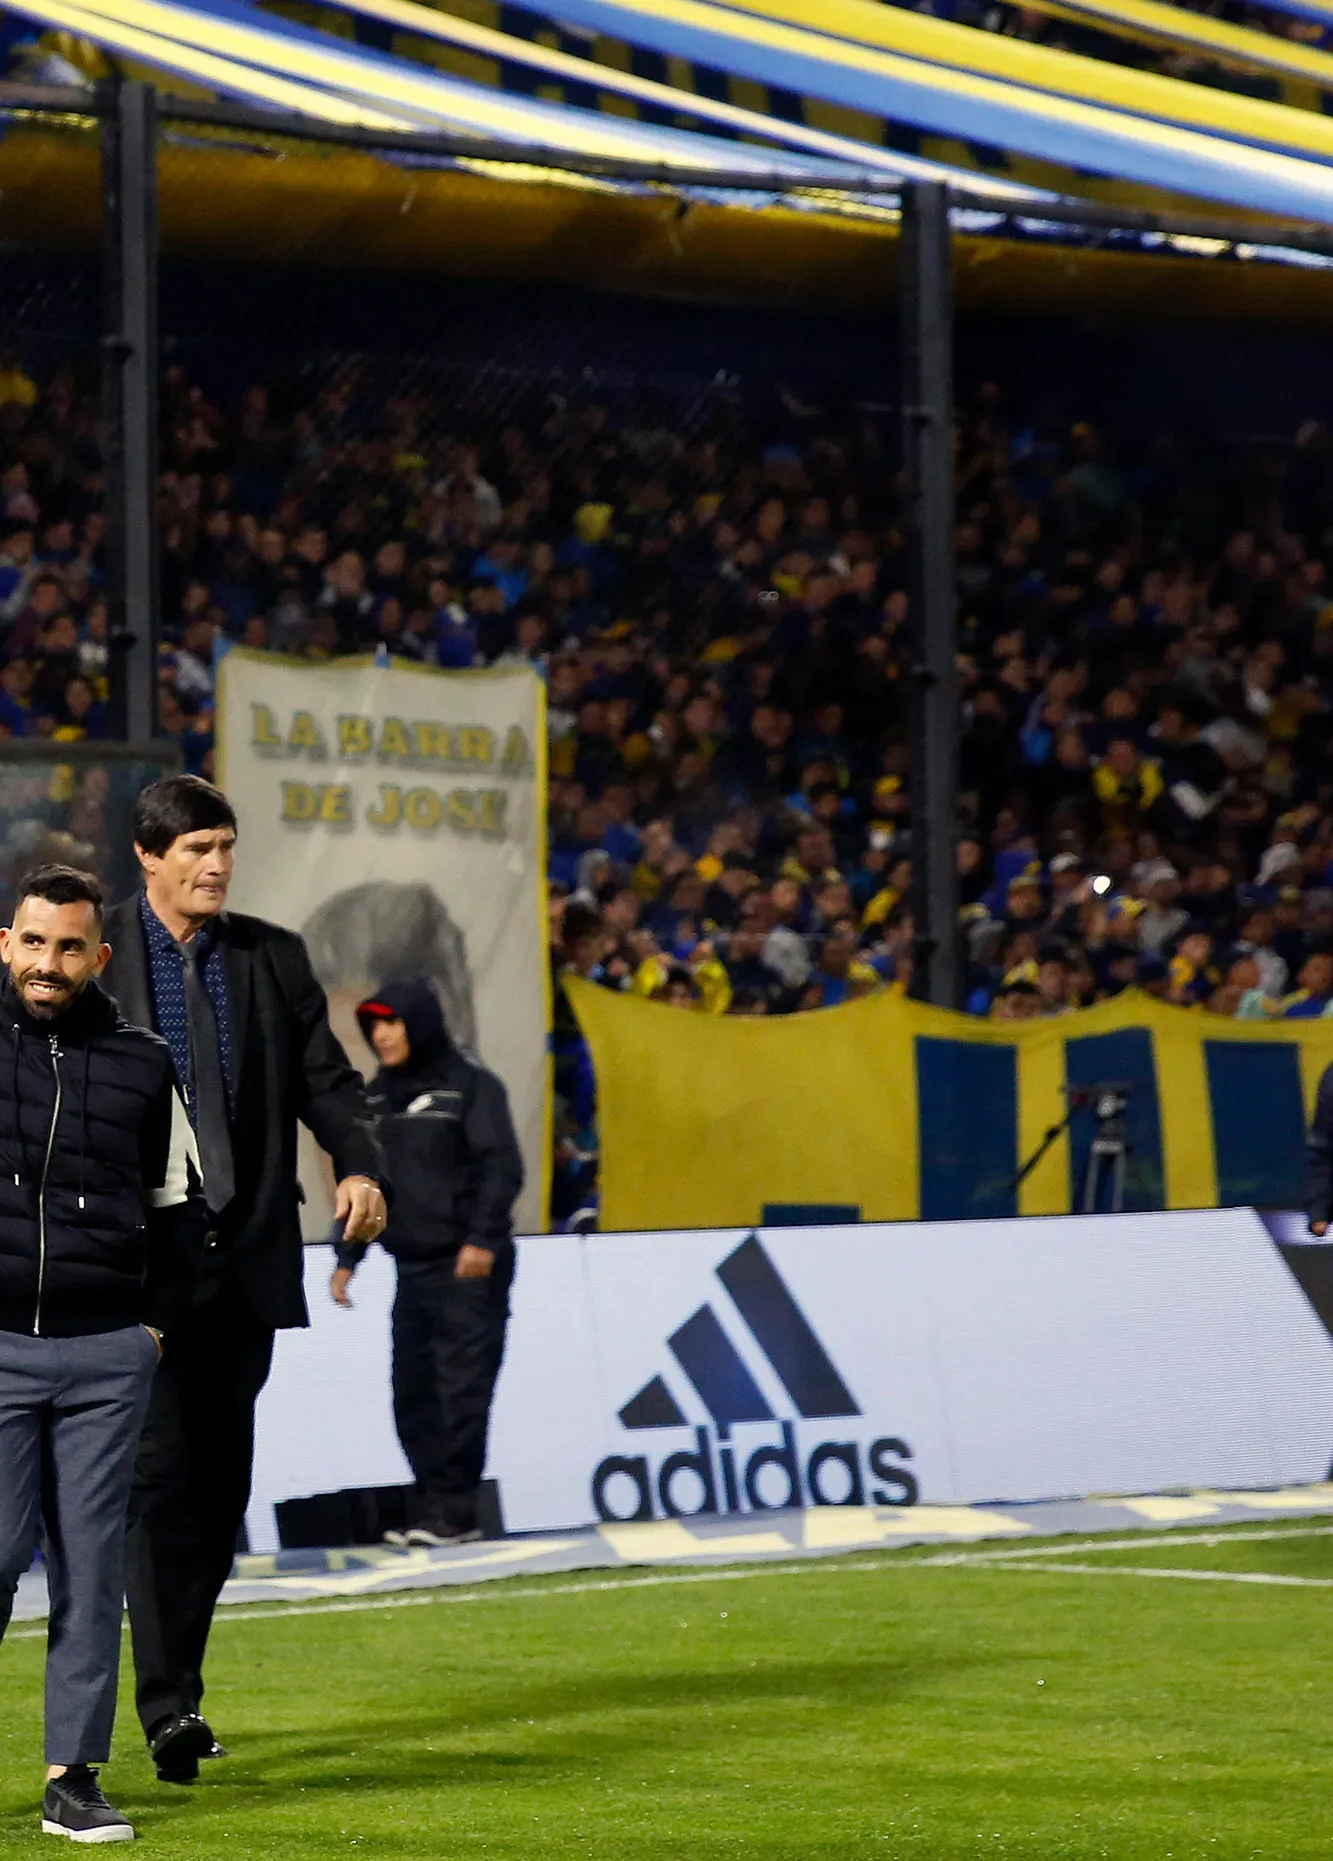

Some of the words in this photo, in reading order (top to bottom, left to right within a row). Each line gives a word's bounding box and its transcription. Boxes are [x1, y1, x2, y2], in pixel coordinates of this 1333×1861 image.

[251, 702, 324, 760] LA
[337, 714, 532, 772] BARRA
[281, 781, 353, 832] DE
[367, 782, 509, 840] JOSE
[592, 1419, 918, 1521] adidas
